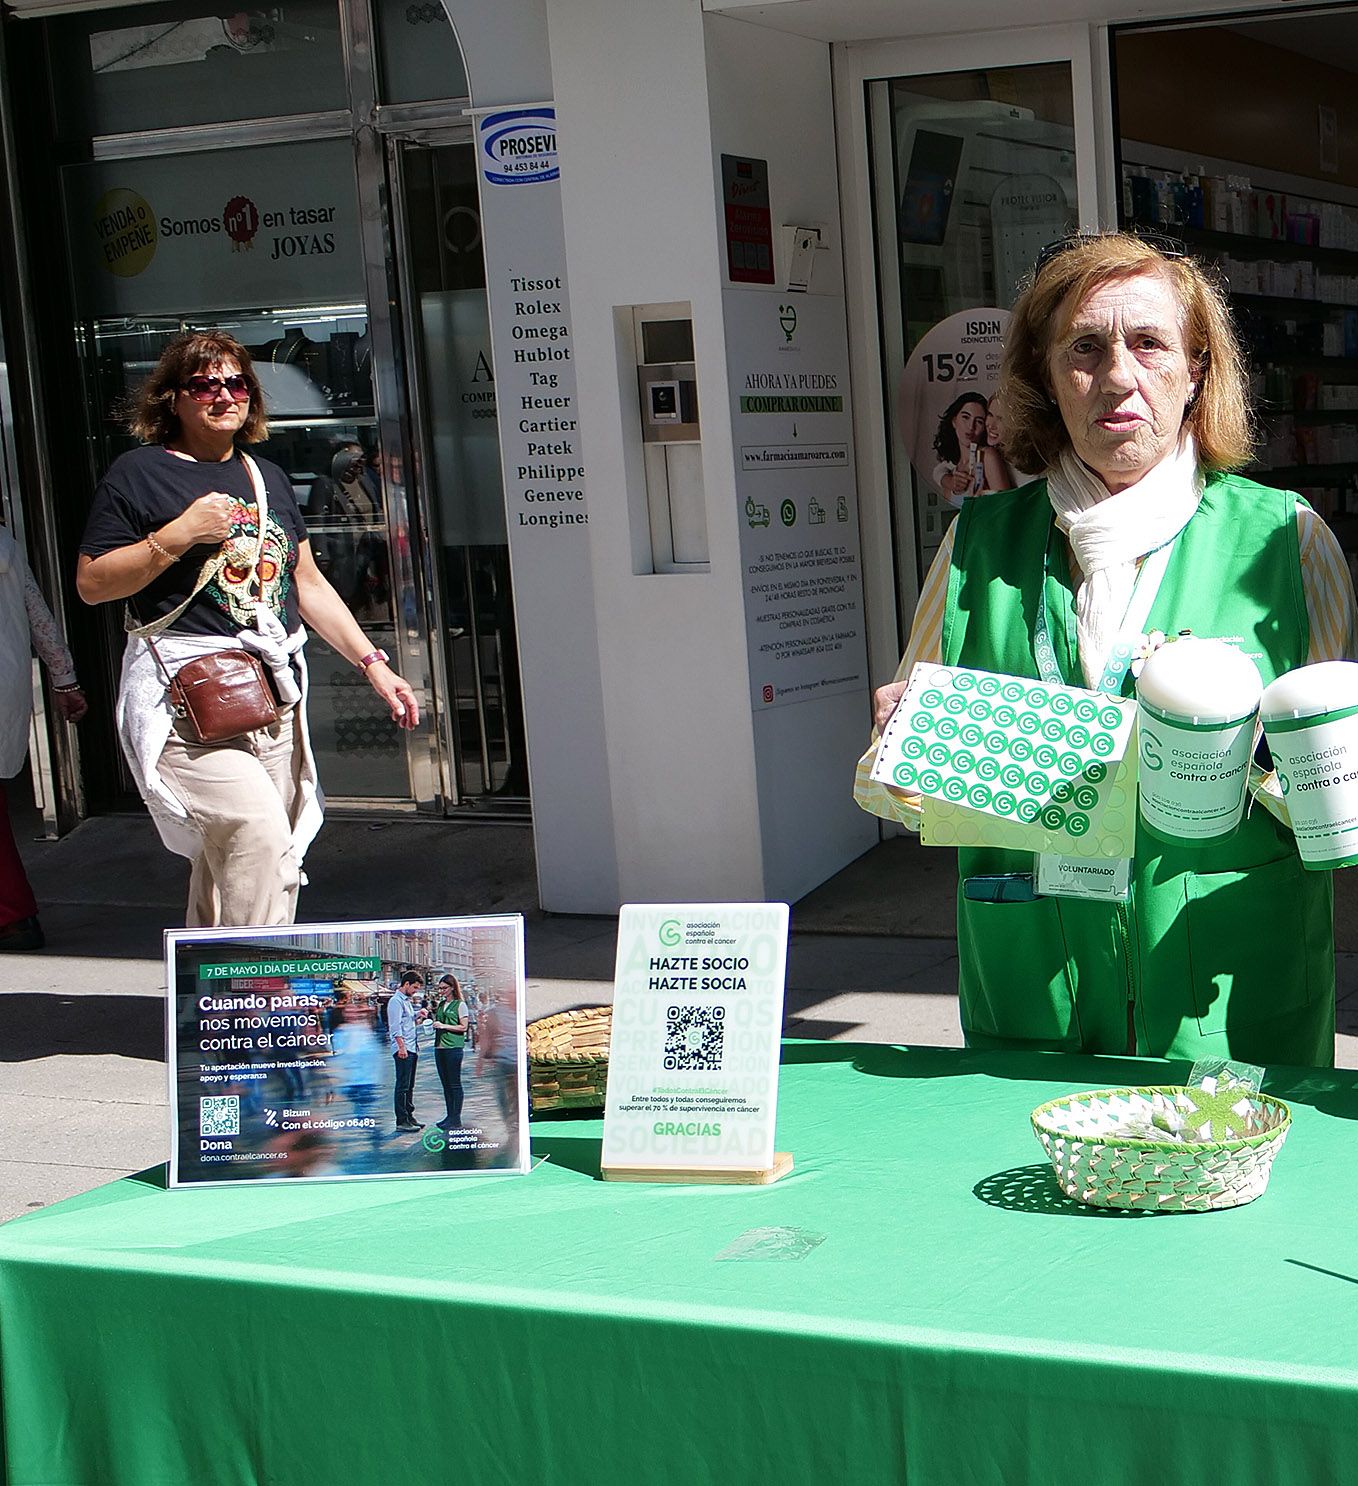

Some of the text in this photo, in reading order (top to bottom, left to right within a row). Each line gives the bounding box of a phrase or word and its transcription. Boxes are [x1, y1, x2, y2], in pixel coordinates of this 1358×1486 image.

[500, 134, 557, 156] PROSEVI
[503, 160, 549, 173] 94 453 84 44
[96, 207, 133, 239] VENDA
[160, 217, 221, 237] Somos
[263, 212, 285, 227] en
[289, 206, 335, 226] tasar
[103, 225, 154, 263] EMPEÑE
[271, 233, 335, 260] JOYAS
[511, 277, 561, 291] Tissot
[515, 301, 561, 315] Rolex
[512, 326, 568, 341] Omega
[960, 336, 1004, 344] ISDINCEUTIC
[514, 348, 570, 362] Hublot
[922, 353, 978, 382] 15%
[530, 373, 558, 388] Tag
[745, 373, 838, 389] AHORA YA PUEDES
[462, 392, 496, 403] COMP
[521, 396, 570, 409] Heuer
[746, 396, 838, 412] COMPRAR ONLINE
[519, 418, 577, 433] Cartier
[527, 441, 573, 456] Patek
[518, 465, 585, 481] Philippe
[524, 489, 583, 502] Geneve
[1171, 749, 1231, 759] asociación
[1289, 746, 1347, 765] asociación
[1171, 760, 1223, 771] española
[1293, 761, 1342, 779] española
[1170, 771, 1207, 782] contra
[1296, 779, 1330, 791] contra
[1058, 865, 1115, 876] VOLUNTARIADO
[207, 959, 373, 977] 7 DE MAYO DÍA DE LA CUESTACIÓN
[650, 957, 749, 970] HAZTE SOCIO
[649, 977, 747, 990] HAZTE SOCIA
[199, 994, 324, 1011] Cuando paras,
[200, 1014, 317, 1031] nos movemos
[200, 1031, 334, 1051] contra el cáncer
[282, 1109, 310, 1118] Bizum
[281, 1118, 376, 1131] Con el código 06483
[653, 1122, 722, 1136] GRACIAS
[200, 1140, 233, 1151] Dona
[200, 1152, 288, 1163] dona.contraelcancer.es
